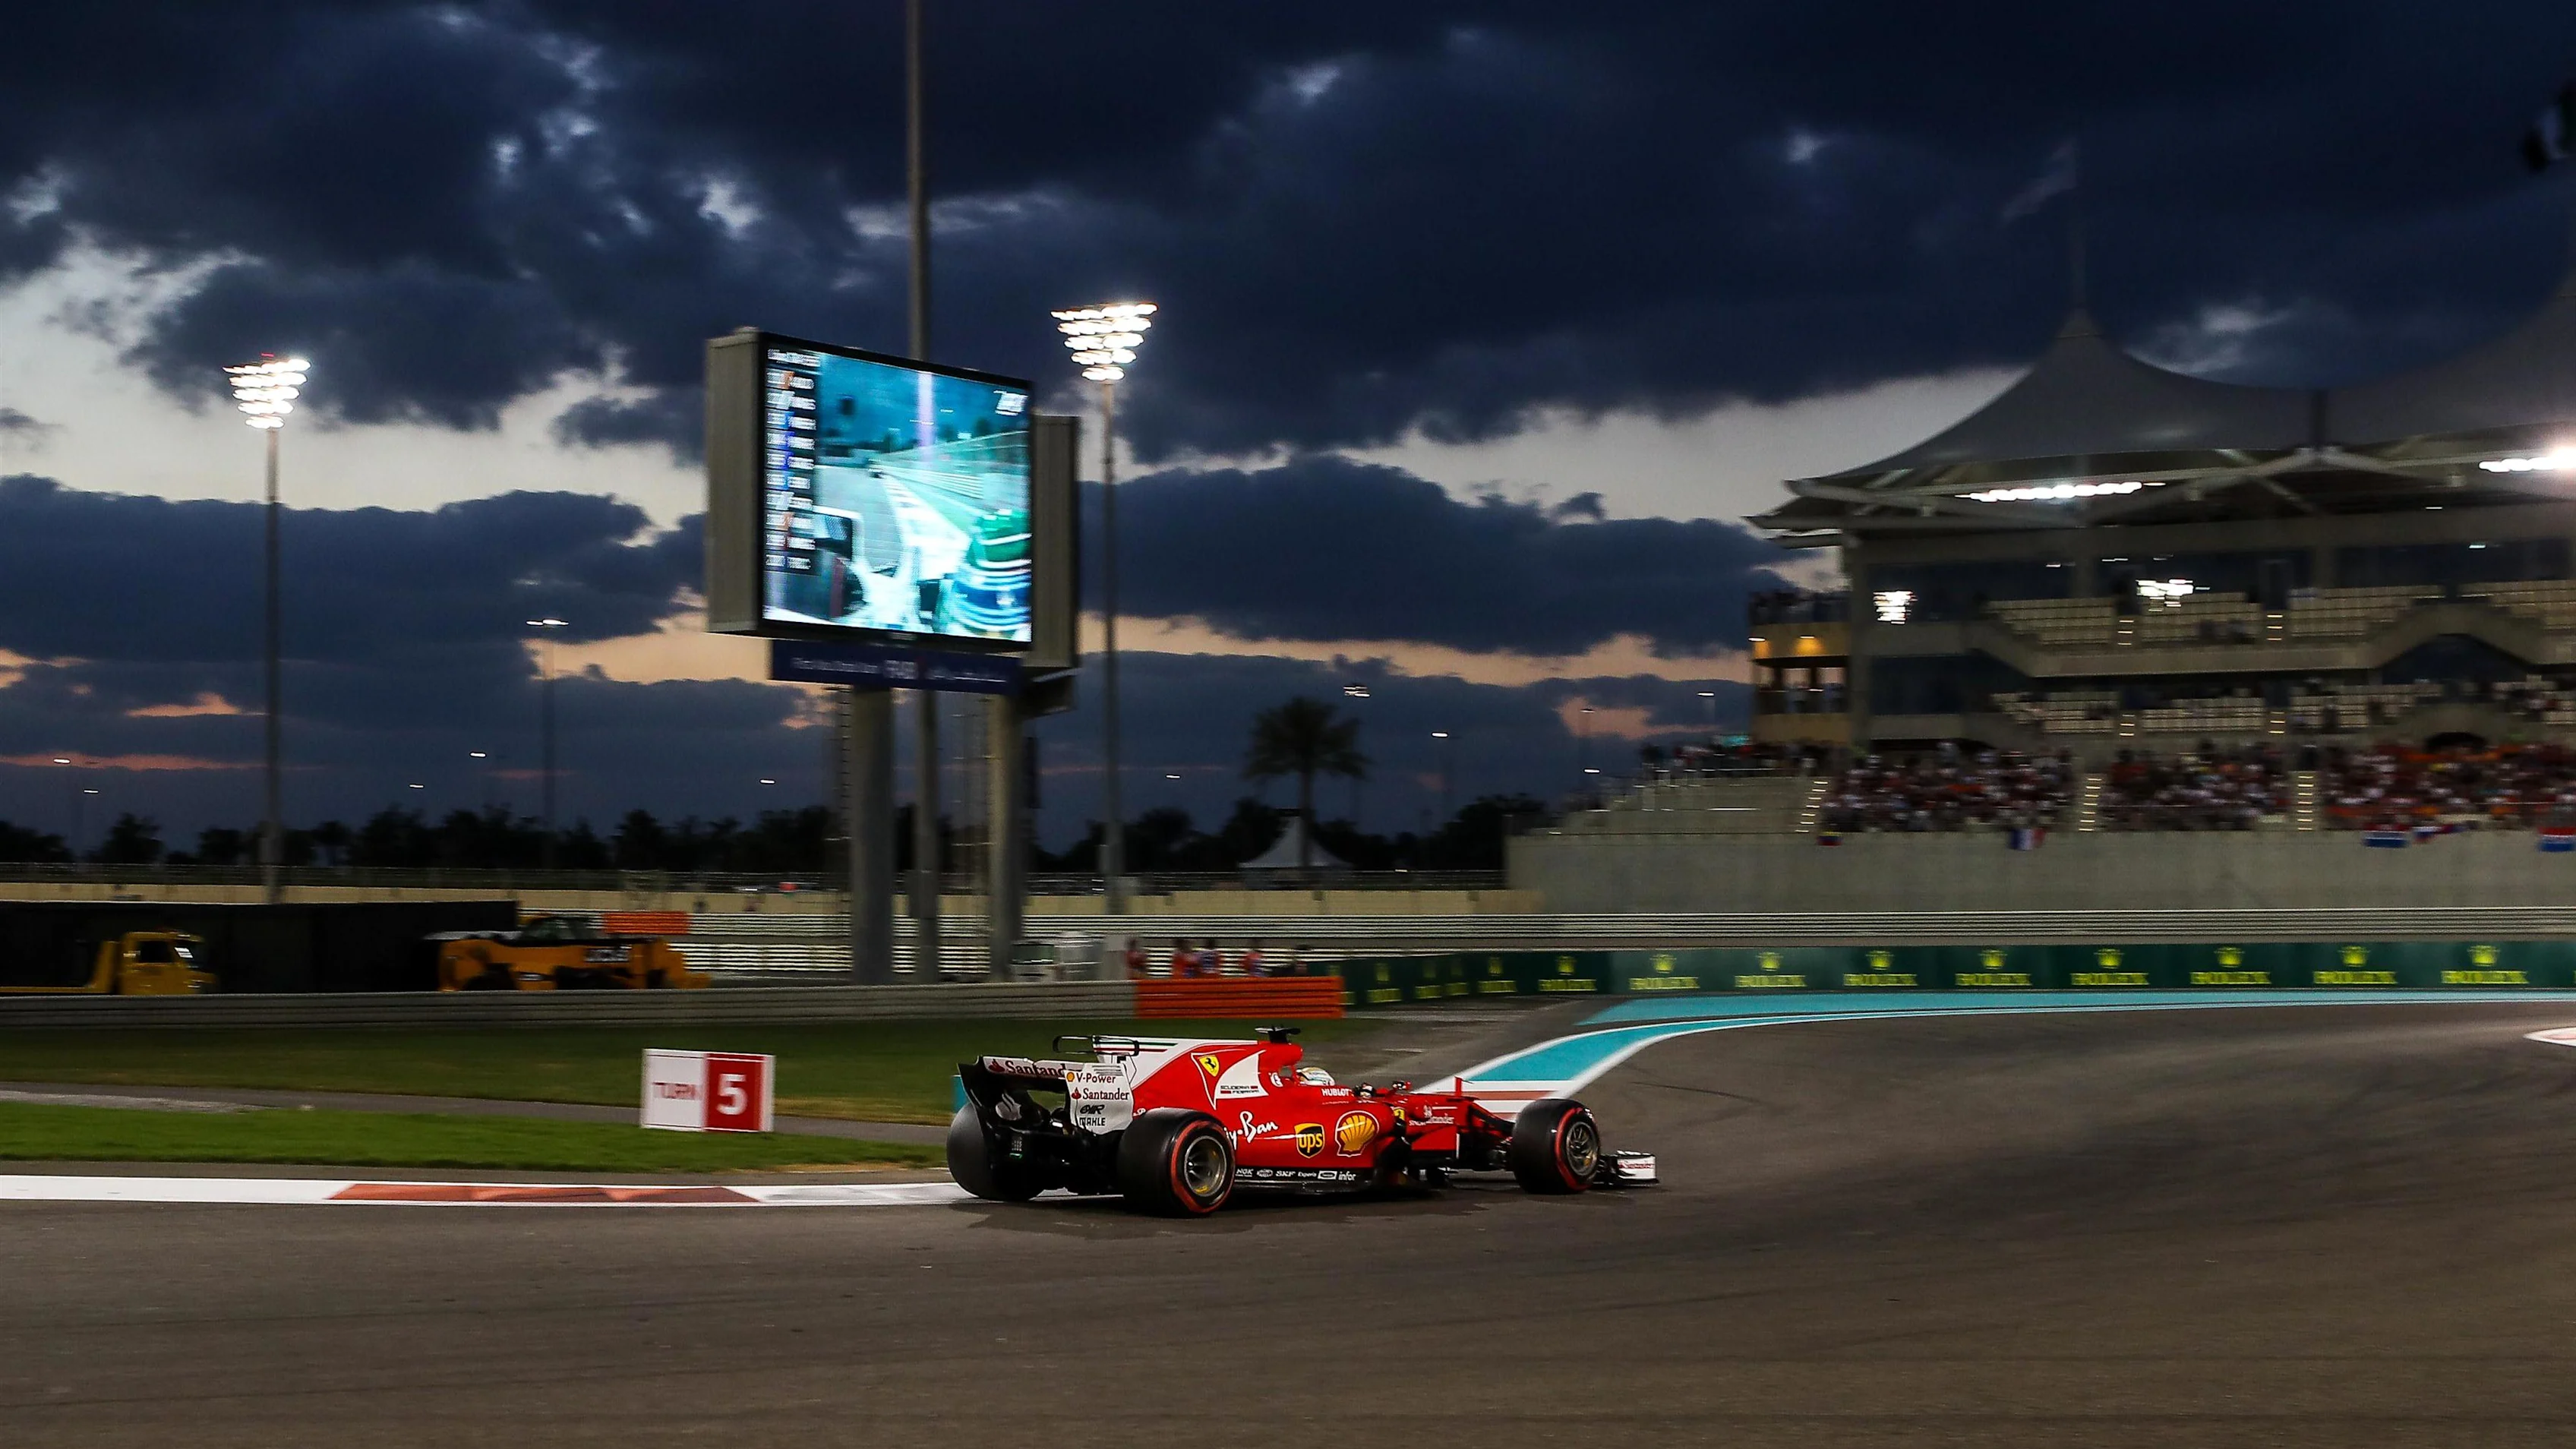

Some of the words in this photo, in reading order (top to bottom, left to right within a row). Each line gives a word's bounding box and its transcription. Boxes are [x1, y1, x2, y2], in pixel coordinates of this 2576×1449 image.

[1005, 1060, 1065, 1077] Santand
[1076, 1072, 1116, 1084] V-Power
[716, 1073, 749, 1116] 5
[1082, 1088, 1130, 1100] Santander
[1321, 1088, 1350, 1097] HUBLOT
[1079, 1116, 1106, 1126] MAHLE
[1299, 1132, 1323, 1154] ups
[1338, 1170, 1357, 1181] infor
